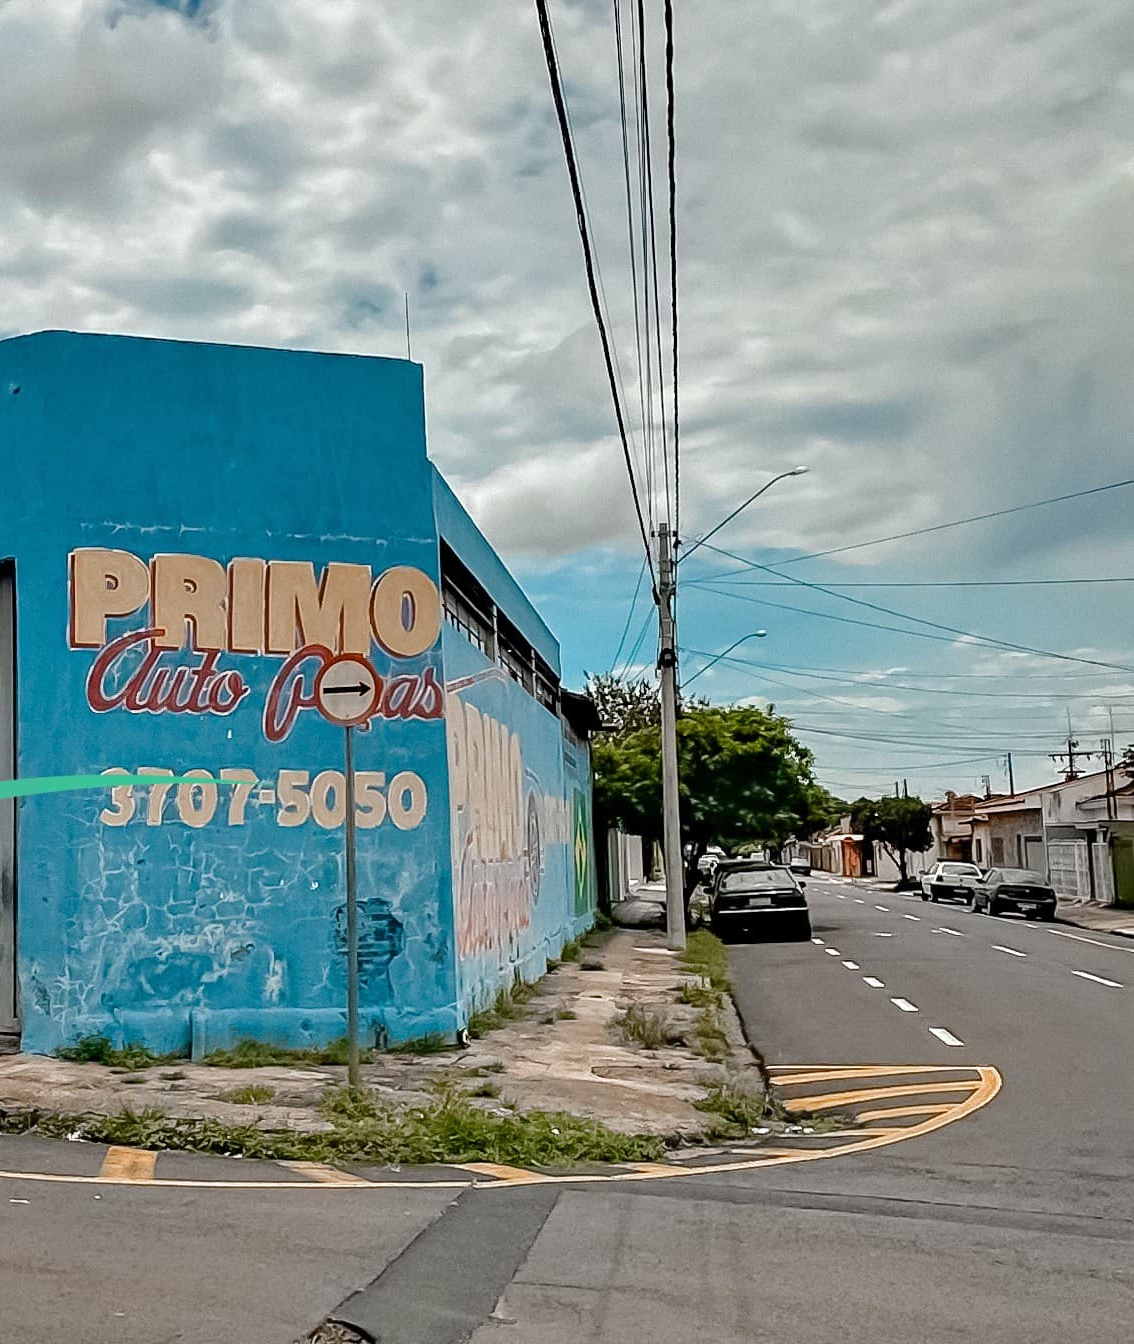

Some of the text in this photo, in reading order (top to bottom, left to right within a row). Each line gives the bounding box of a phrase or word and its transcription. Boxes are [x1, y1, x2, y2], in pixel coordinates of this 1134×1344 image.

[69, 547, 441, 657] PRIMO
[86, 629, 443, 742] Auto Pas
[99, 767, 428, 830] 3707-5050
